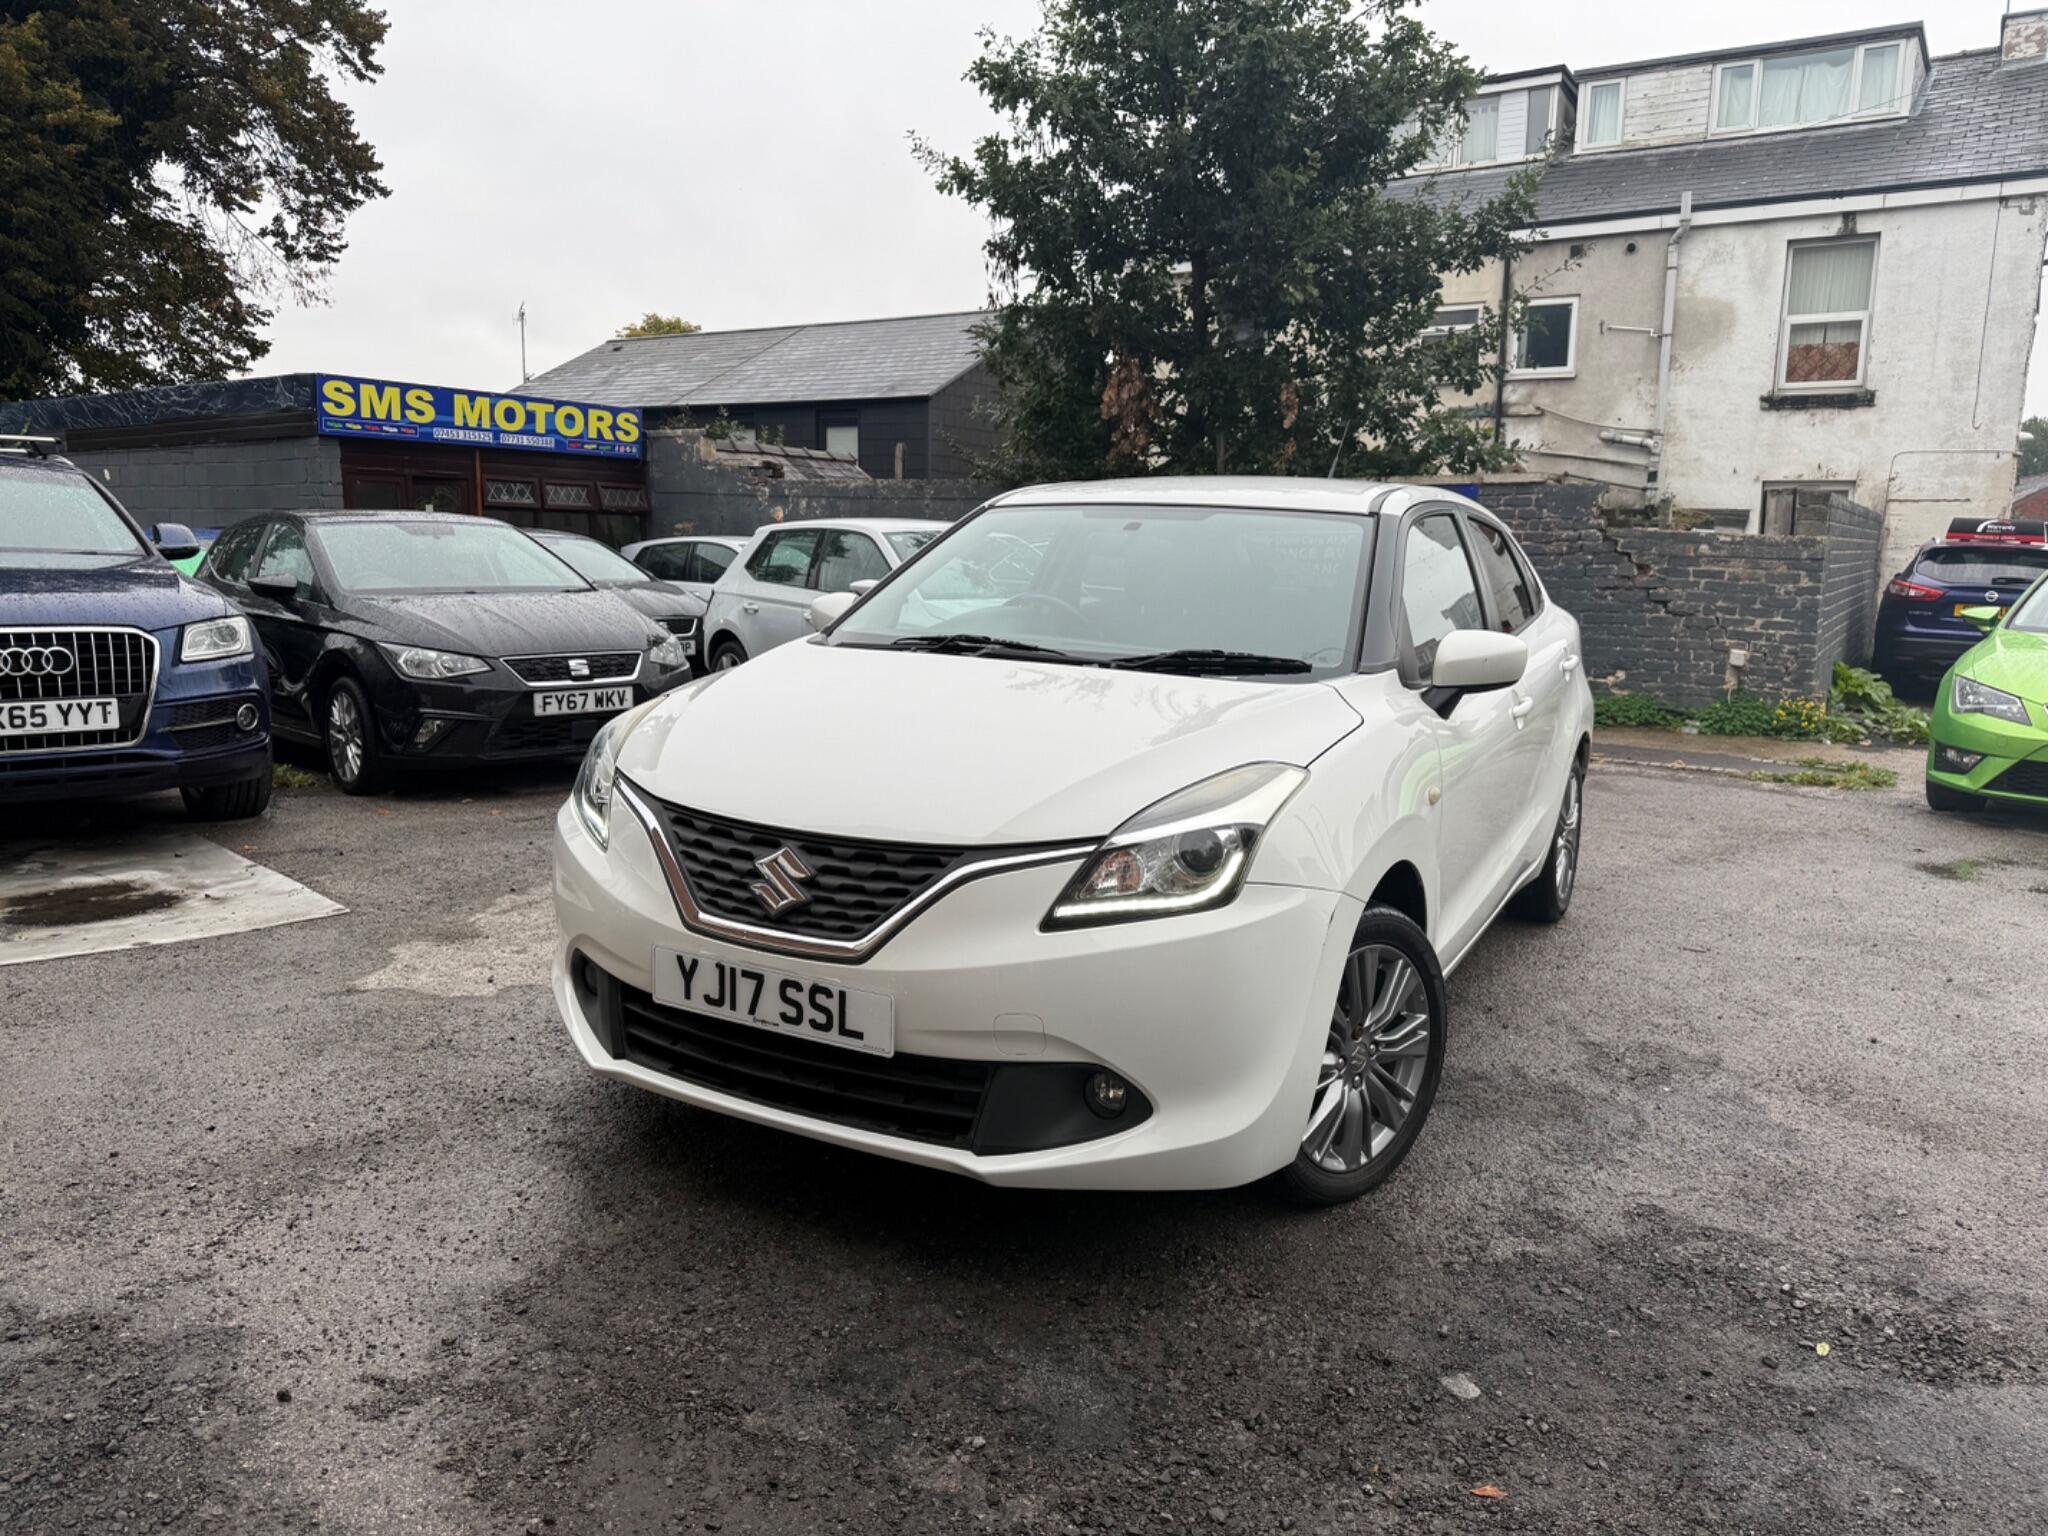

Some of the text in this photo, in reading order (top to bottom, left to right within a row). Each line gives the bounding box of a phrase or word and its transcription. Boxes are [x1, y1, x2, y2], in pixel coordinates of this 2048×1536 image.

[322, 379, 639, 442] SMS MOTORS
[56, 701, 112, 726] YYT
[542, 690, 626, 712] FY67 WKV
[676, 954, 864, 1040] YJ17 SSL
